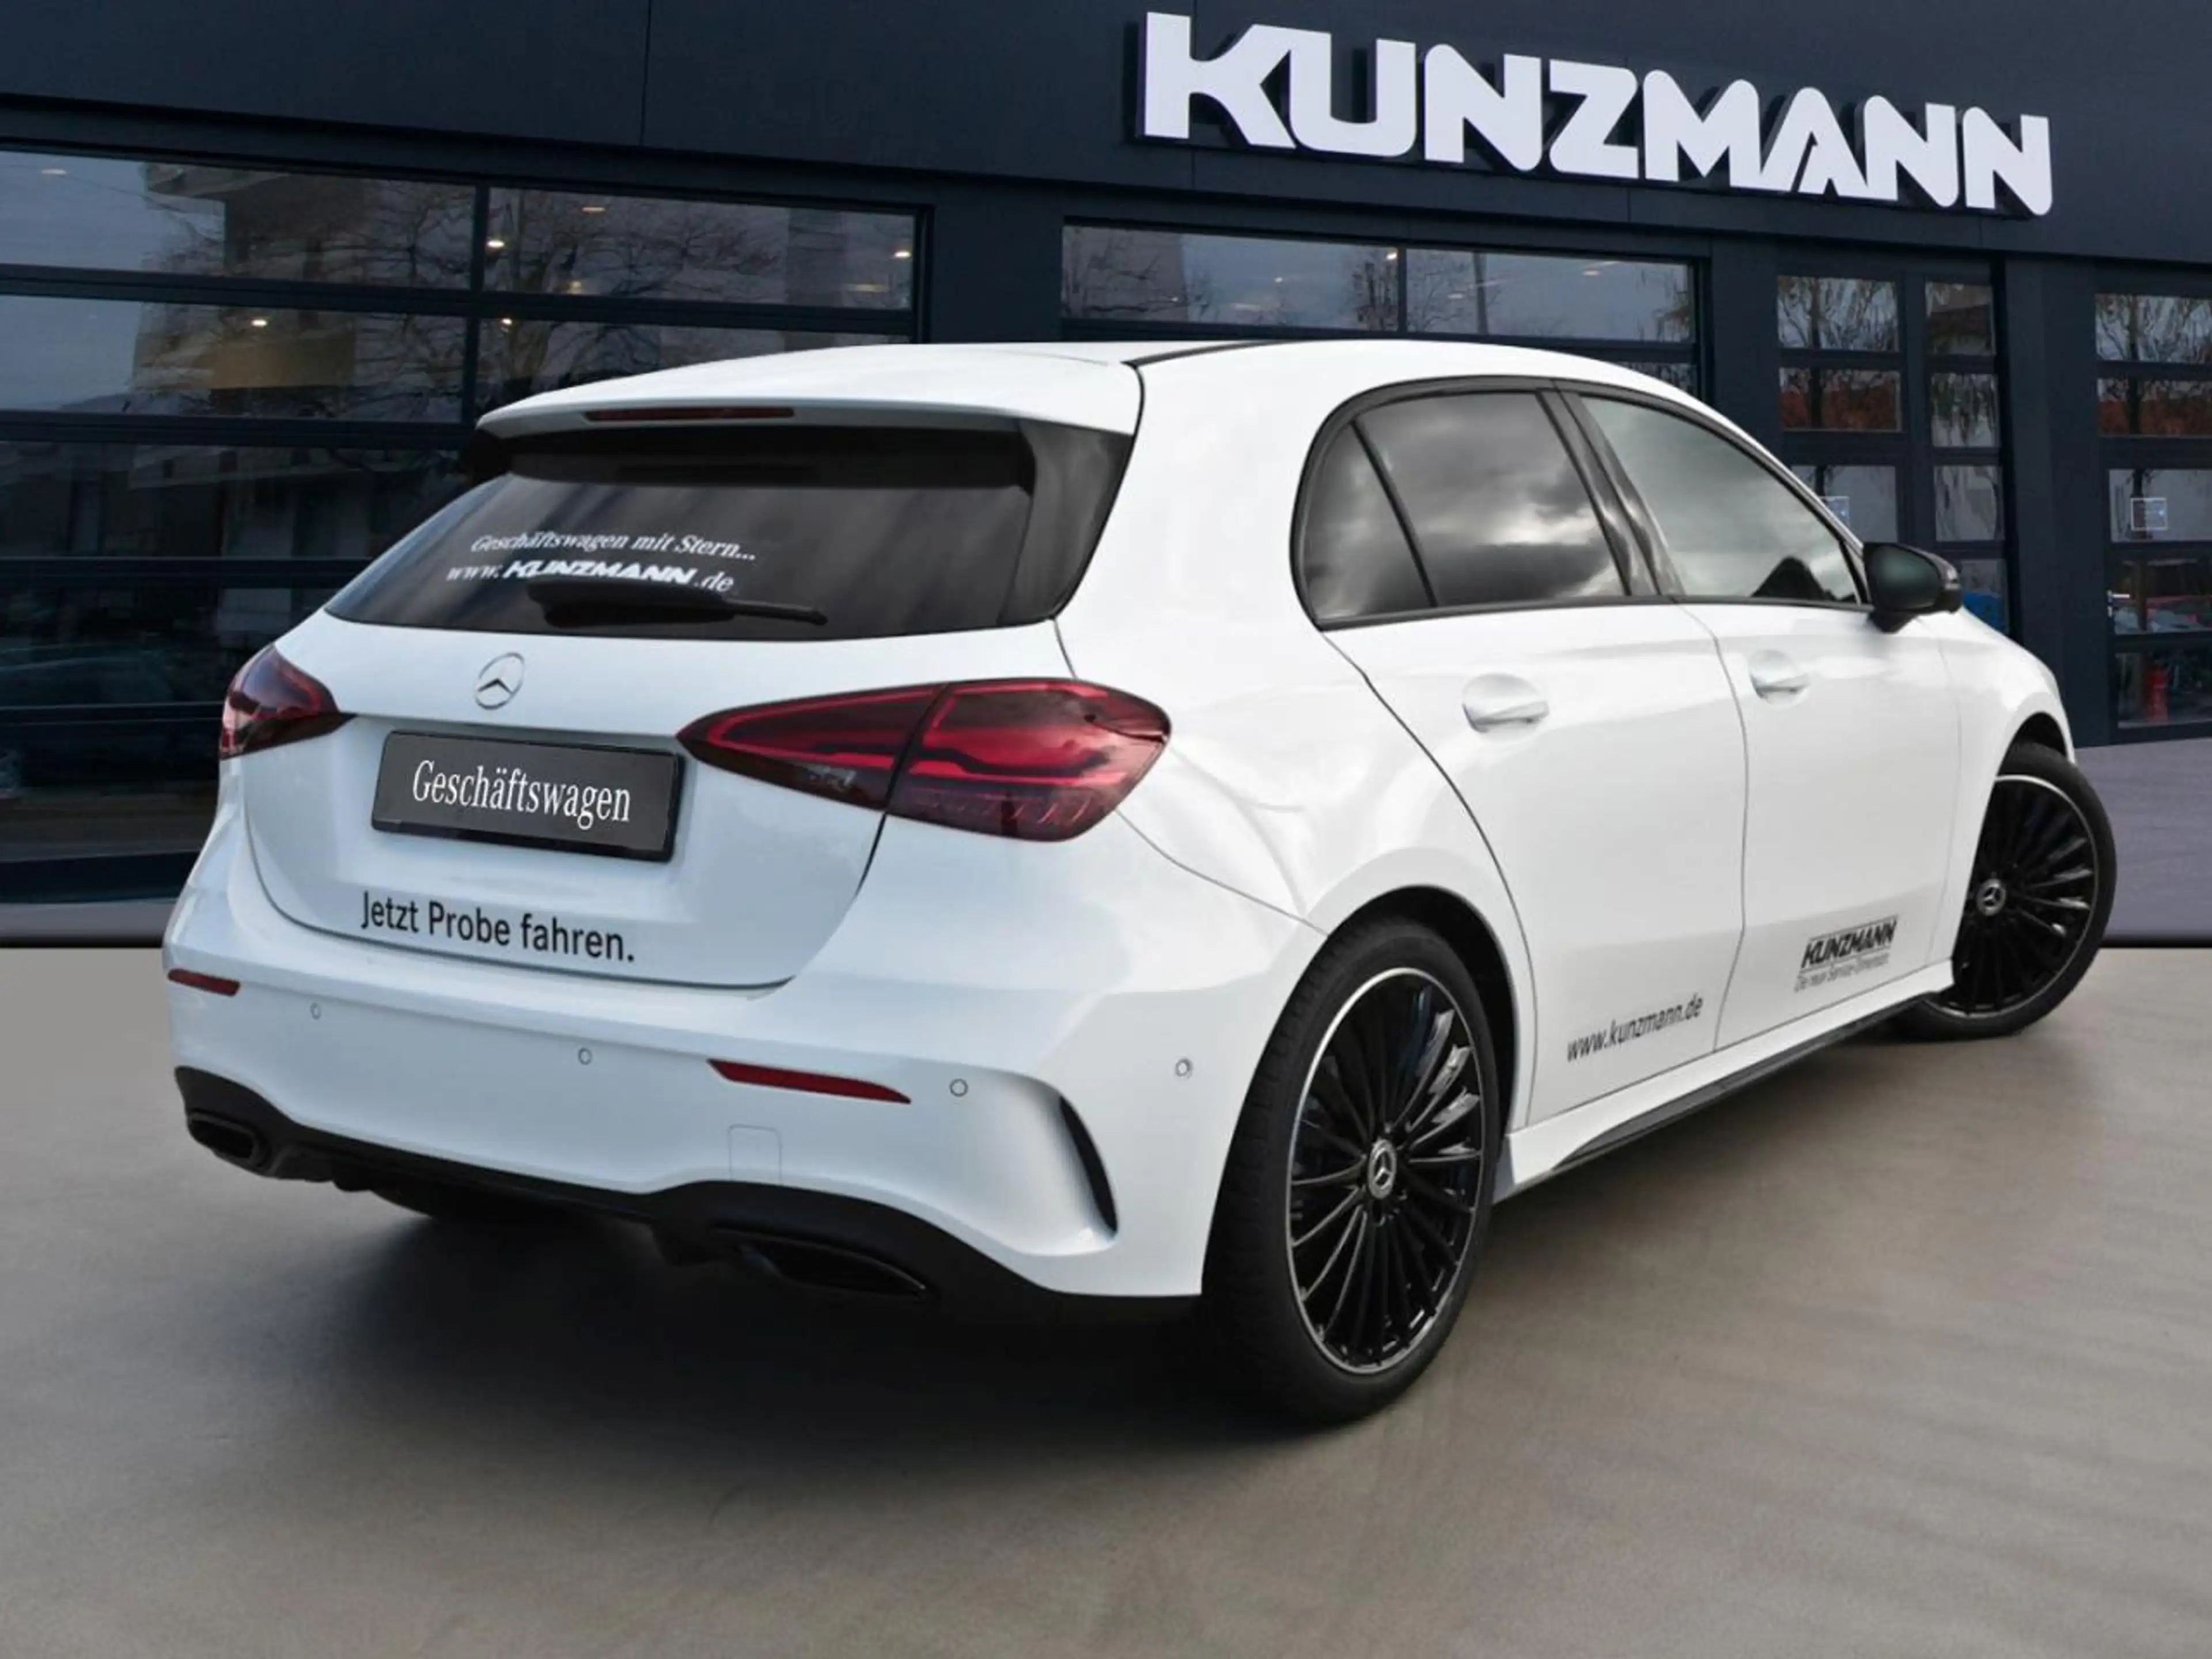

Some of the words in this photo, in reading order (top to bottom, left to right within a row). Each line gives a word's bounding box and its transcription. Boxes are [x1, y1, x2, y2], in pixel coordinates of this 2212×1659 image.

[1144, 12, 2053, 216] KUNZMANN
[470, 531, 628, 552] Geschäftswagen
[630, 533, 675, 551] mit
[675, 534, 756, 561] Stern...
[412, 760, 631, 830] Geschäftswagen
[361, 892, 419, 933] Jetzt
[428, 902, 511, 946] Probe
[521, 913, 634, 962] fahren.
[1800, 918, 1897, 969] KUNZMANN
[1567, 993, 1703, 1062] www.kunzmann.de
